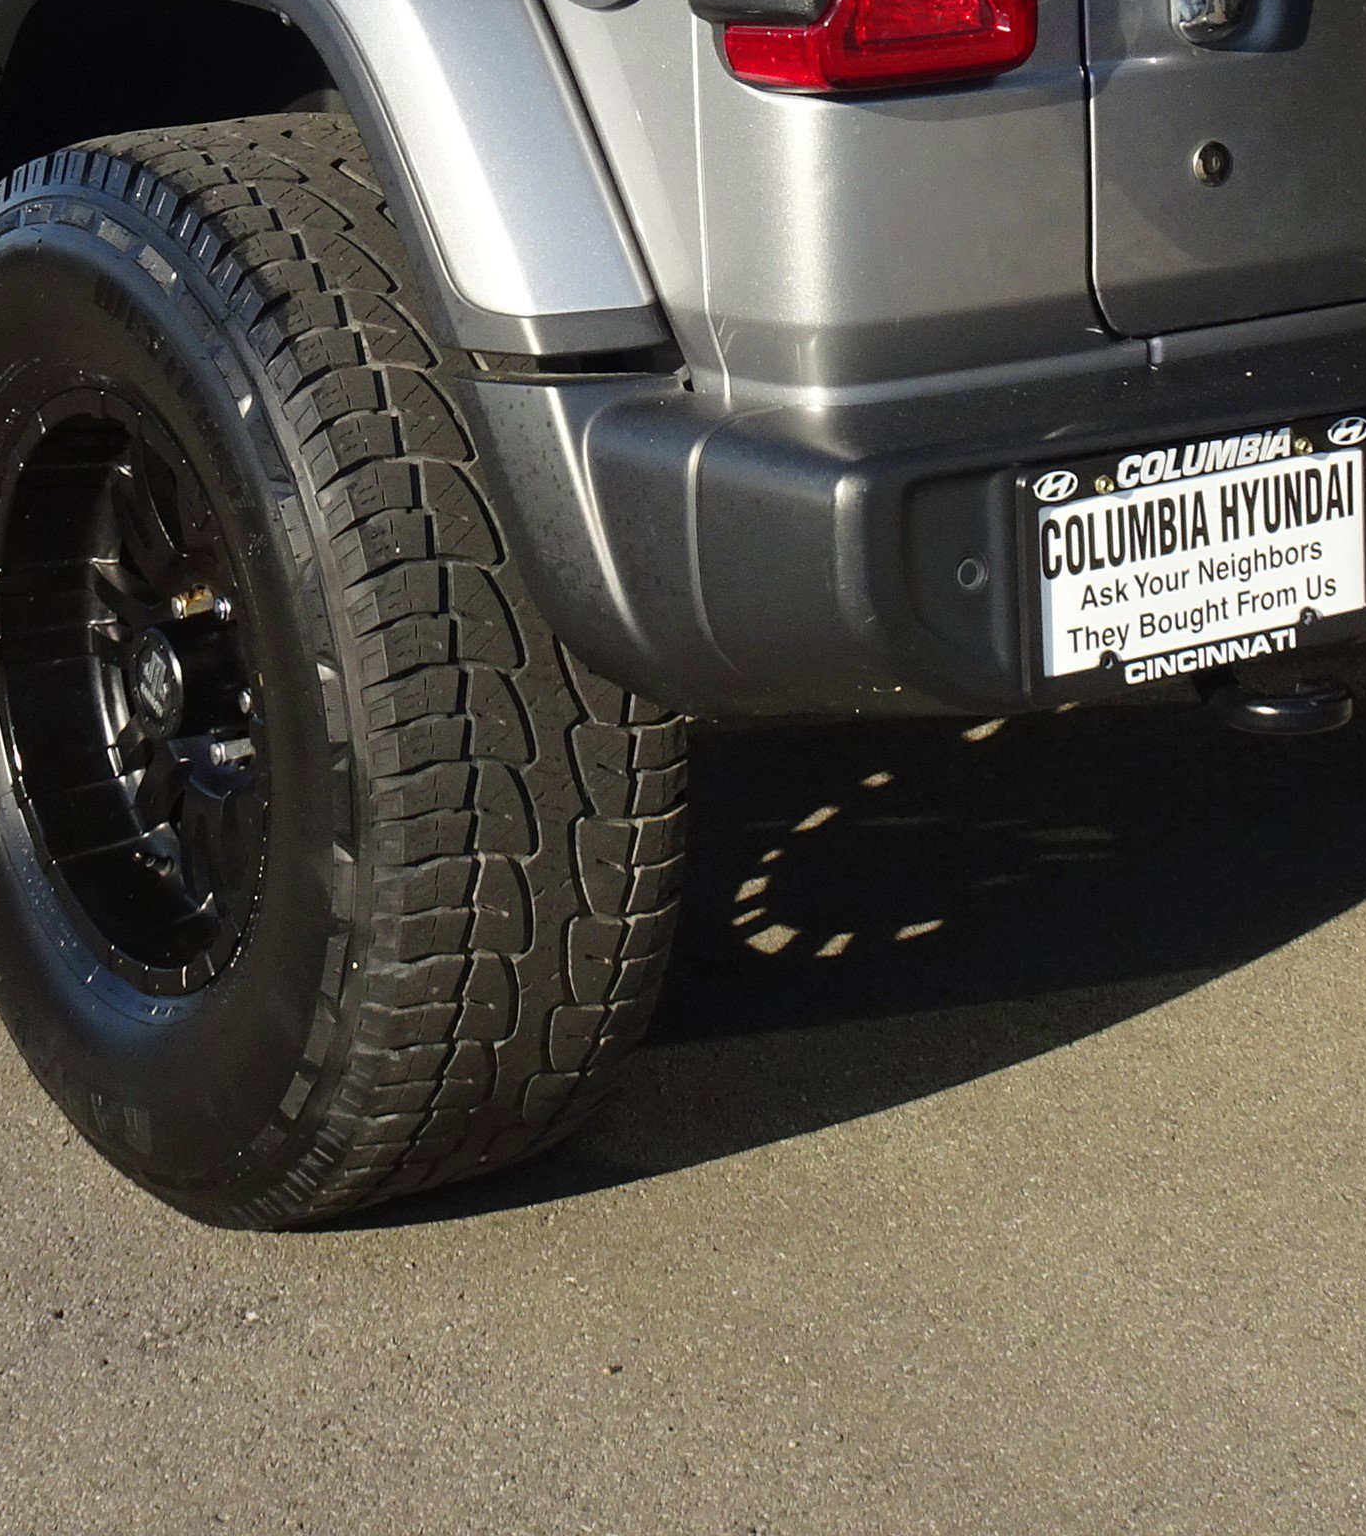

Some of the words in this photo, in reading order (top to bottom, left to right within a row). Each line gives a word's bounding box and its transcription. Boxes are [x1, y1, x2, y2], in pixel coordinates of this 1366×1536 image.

[1116, 427, 1292, 489] COLUMBIA
[1040, 489, 1211, 581] COLUMBIA
[1219, 459, 1356, 543] HYUNDAI
[1080, 578, 1130, 611] Ask
[1133, 568, 1191, 599] Your
[1197, 540, 1323, 586] Neighbors
[1067, 622, 1131, 655] They
[1138, 598, 1230, 640] Bought
[1237, 584, 1298, 617] From
[1305, 573, 1338, 600] Us
[1123, 628, 1297, 685] CINCINNATI
